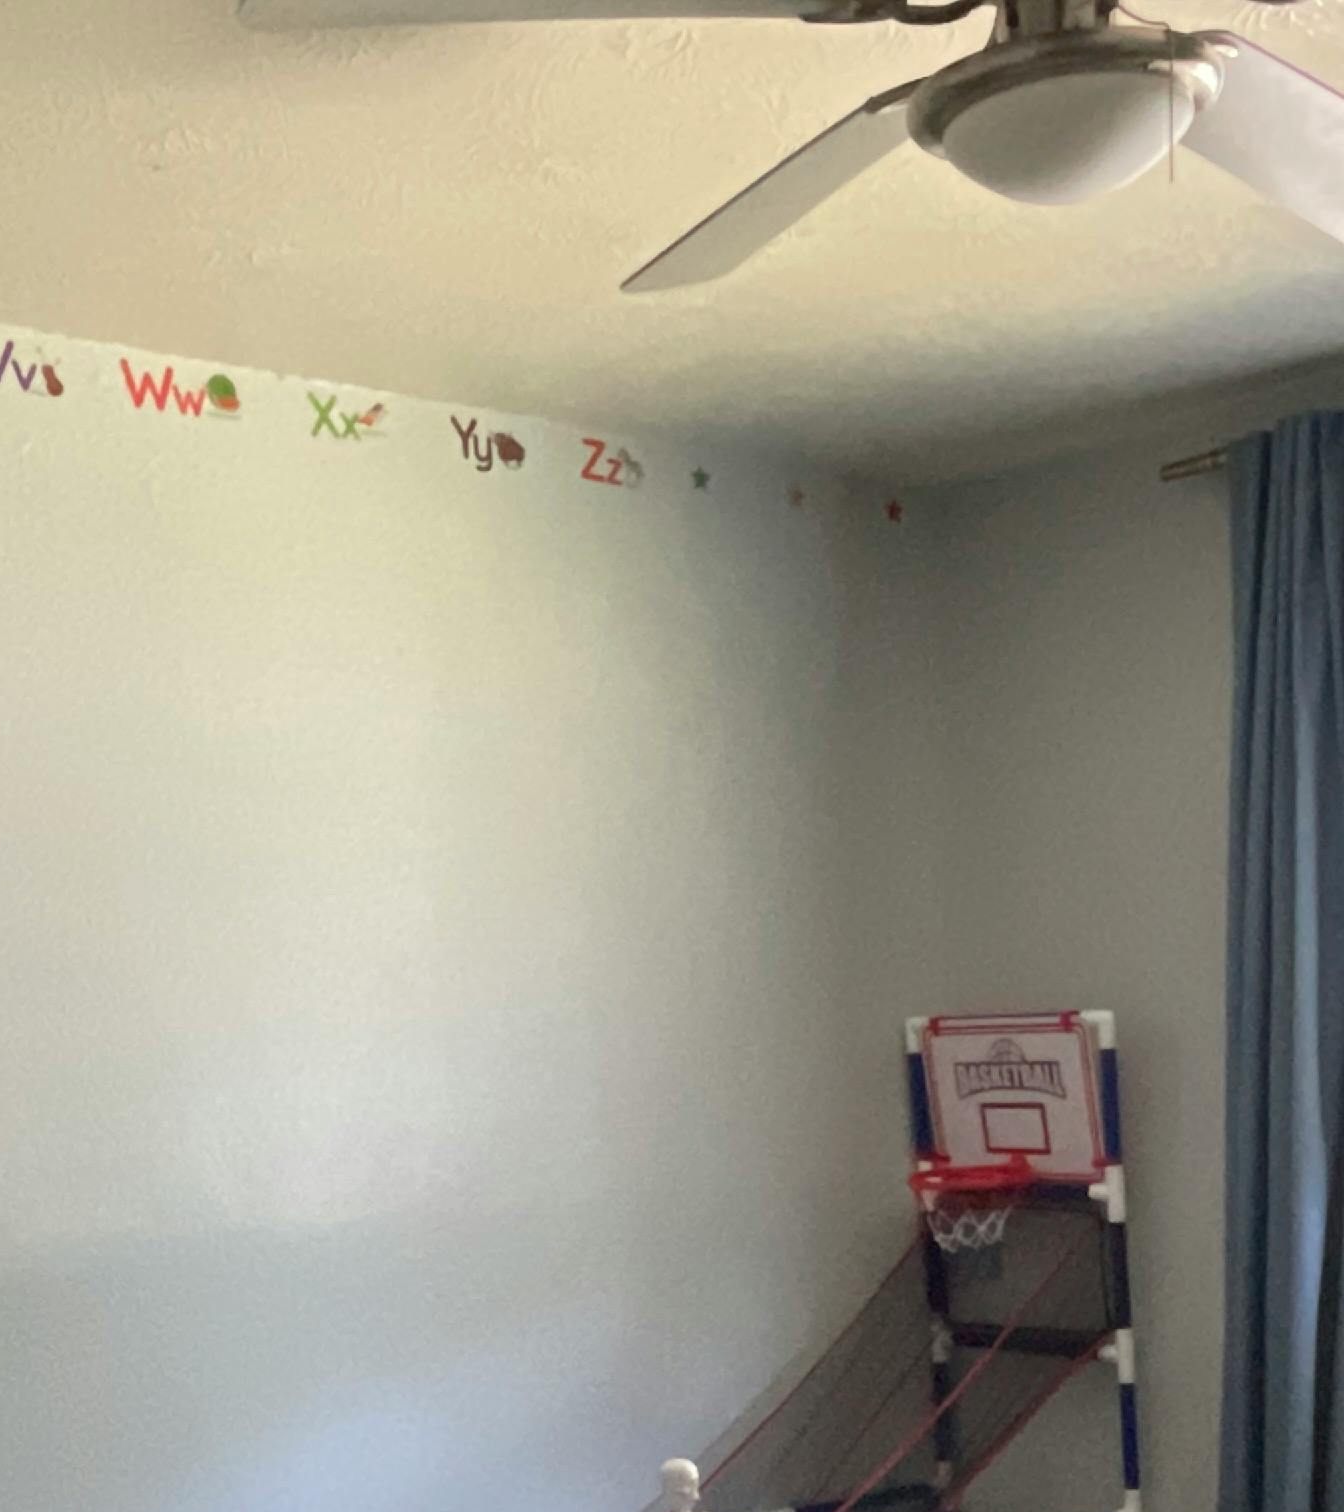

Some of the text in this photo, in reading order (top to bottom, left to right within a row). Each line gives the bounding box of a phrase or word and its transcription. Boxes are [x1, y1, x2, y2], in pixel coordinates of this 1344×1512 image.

[120, 357, 206, 416] Ww
[307, 391, 361, 441] Xx
[450, 414, 493, 472] Yy
[581, 437, 624, 486] Zz
